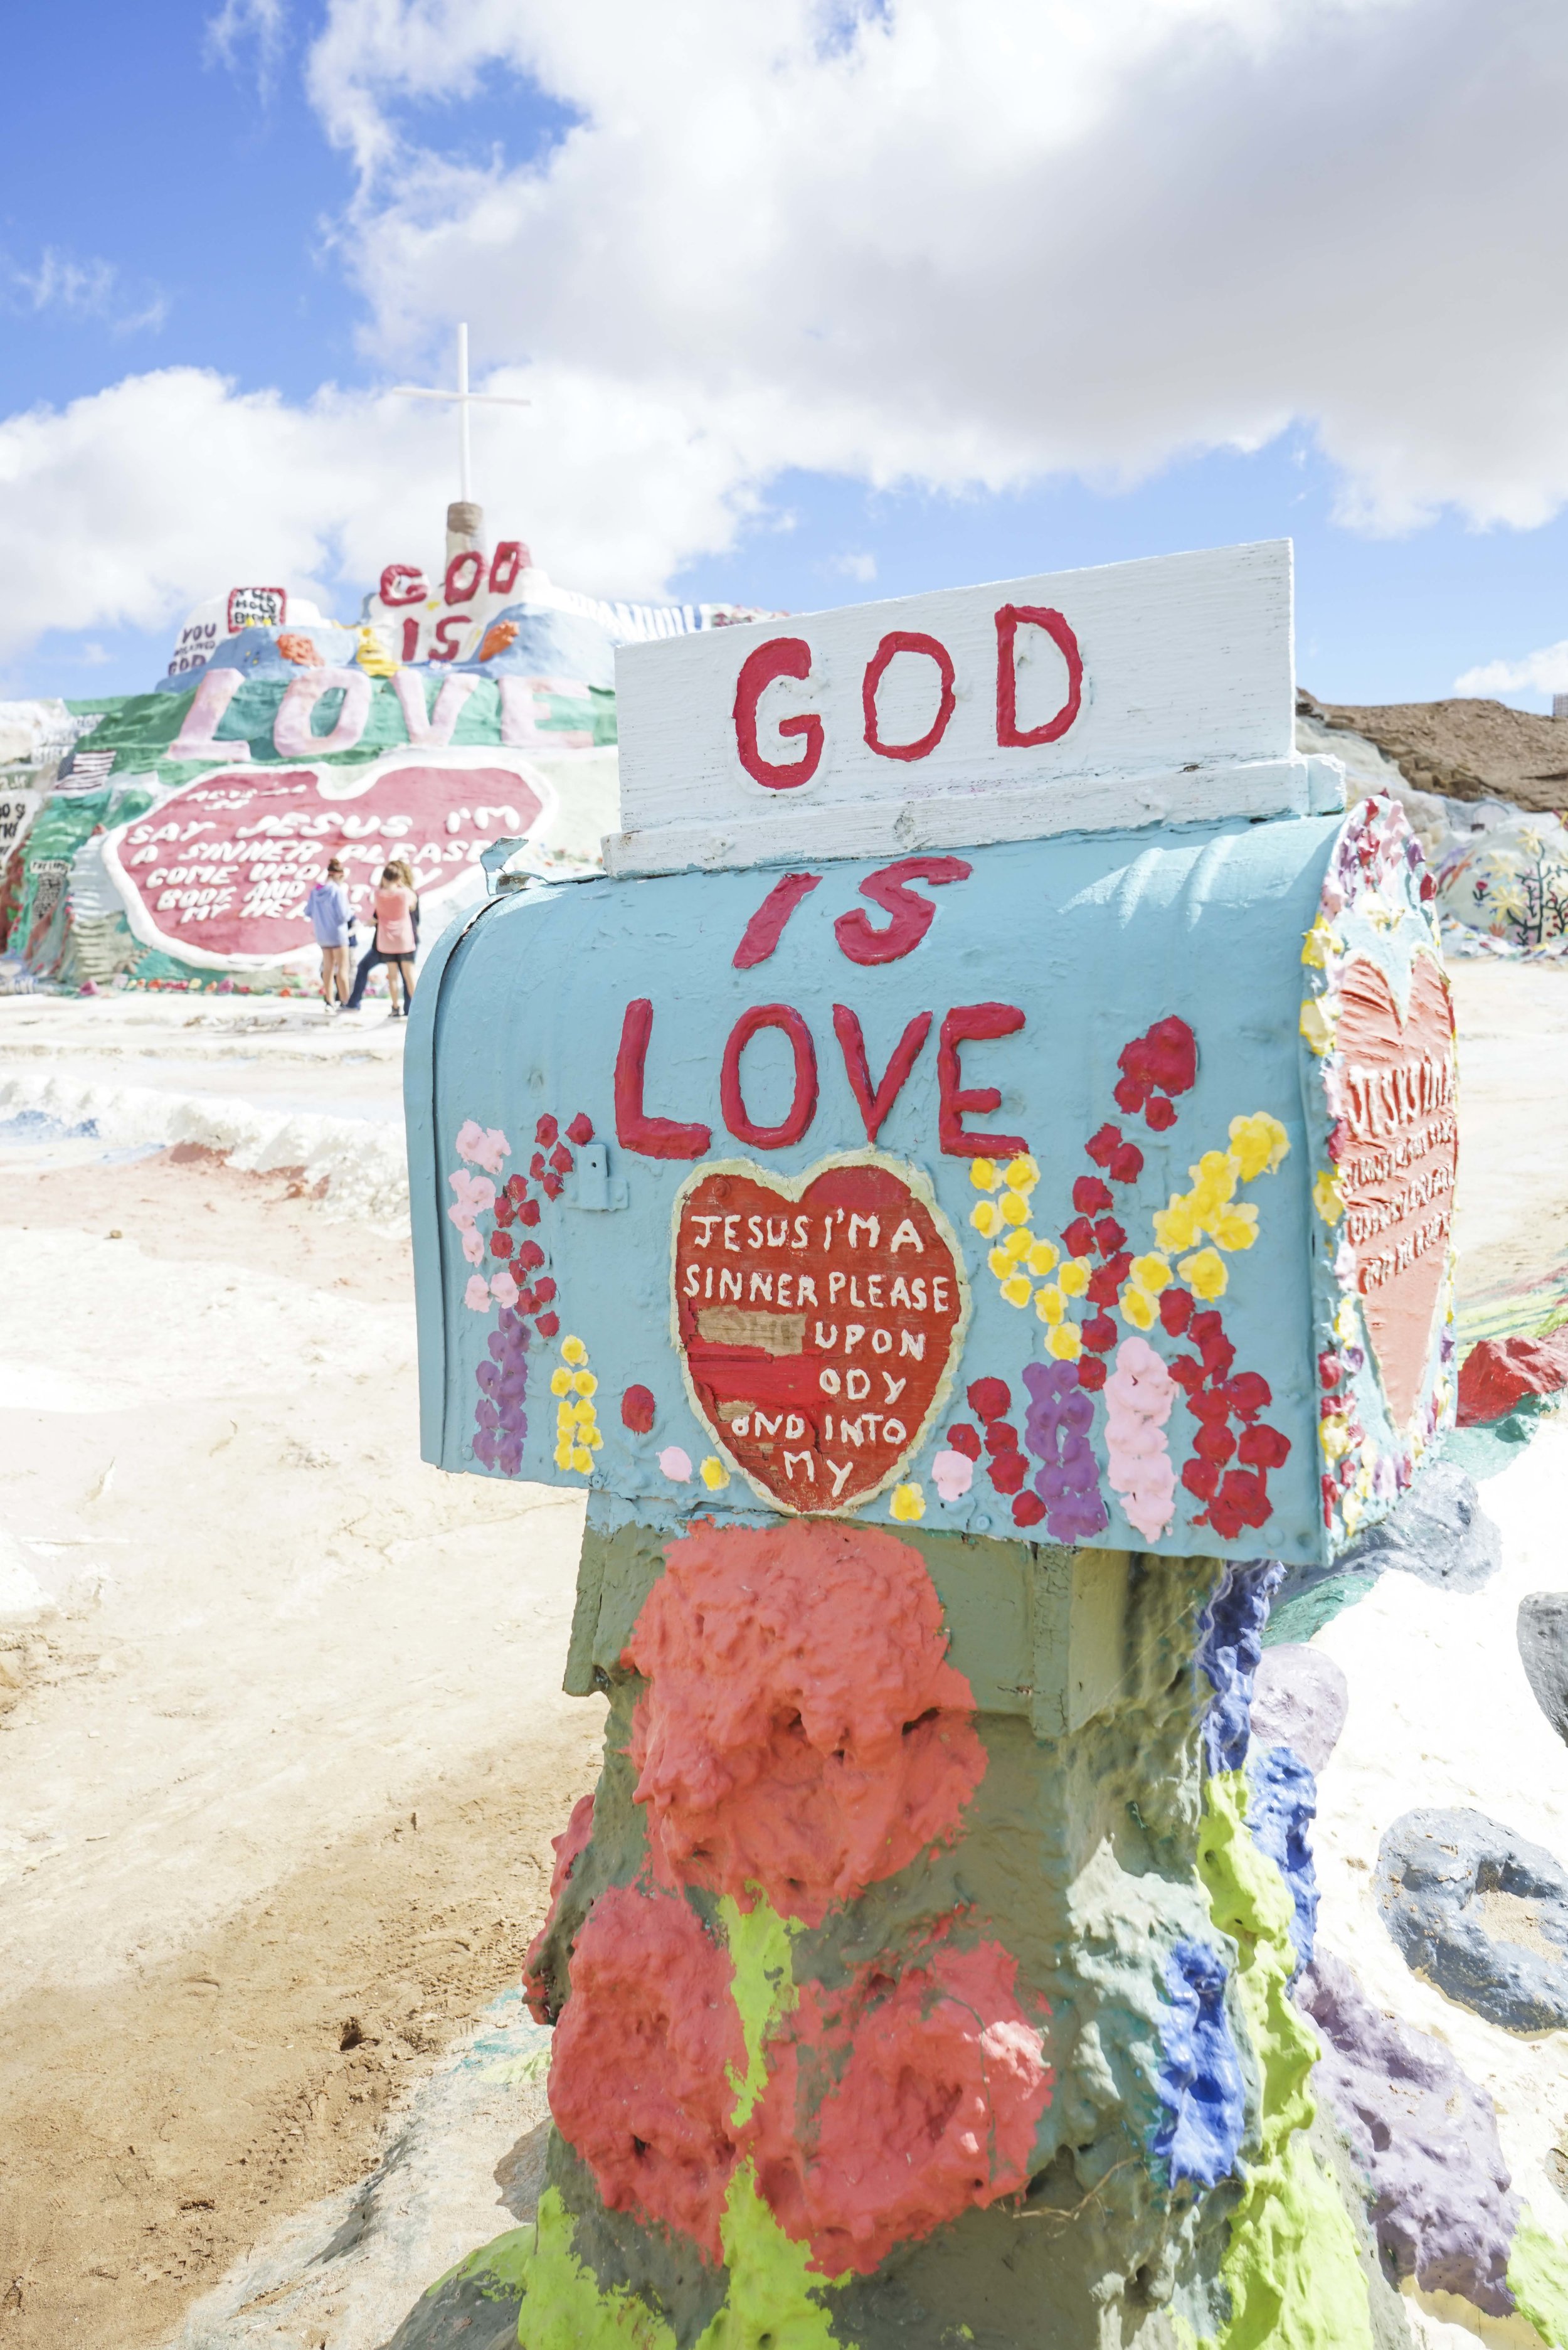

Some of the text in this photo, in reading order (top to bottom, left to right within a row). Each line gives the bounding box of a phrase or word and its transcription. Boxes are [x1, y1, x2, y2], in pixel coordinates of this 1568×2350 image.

[379, 541, 532, 606] GOD
[235, 600, 276, 614] HOLY
[235, 611, 276, 625] BBE
[182, 622, 216, 644] YOU
[401, 615, 472, 662] IS
[168, 654, 206, 676] GOD
[162, 667, 595, 762] LOVE
[732, 603, 1084, 790] GOD
[128, 805, 520, 845] SAY JESUS I'M
[130, 838, 493, 866] A SINNER PLEASE
[146, 864, 239, 889] COME
[157, 880, 306, 911] BODY AND
[180, 902, 231, 924] MY
[732, 854, 973, 970] IS
[613, 997, 1030, 1161] LOVE
[691, 1207, 924, 1253] JESUS I'M A
[683, 1263, 950, 1313] SINNER PLEASE
[815, 1321, 925, 1361] UPON
[819, 1368, 907, 1405] ODY
[825, 1413, 907, 1447] INTO
[783, 1450, 853, 1498] MY
